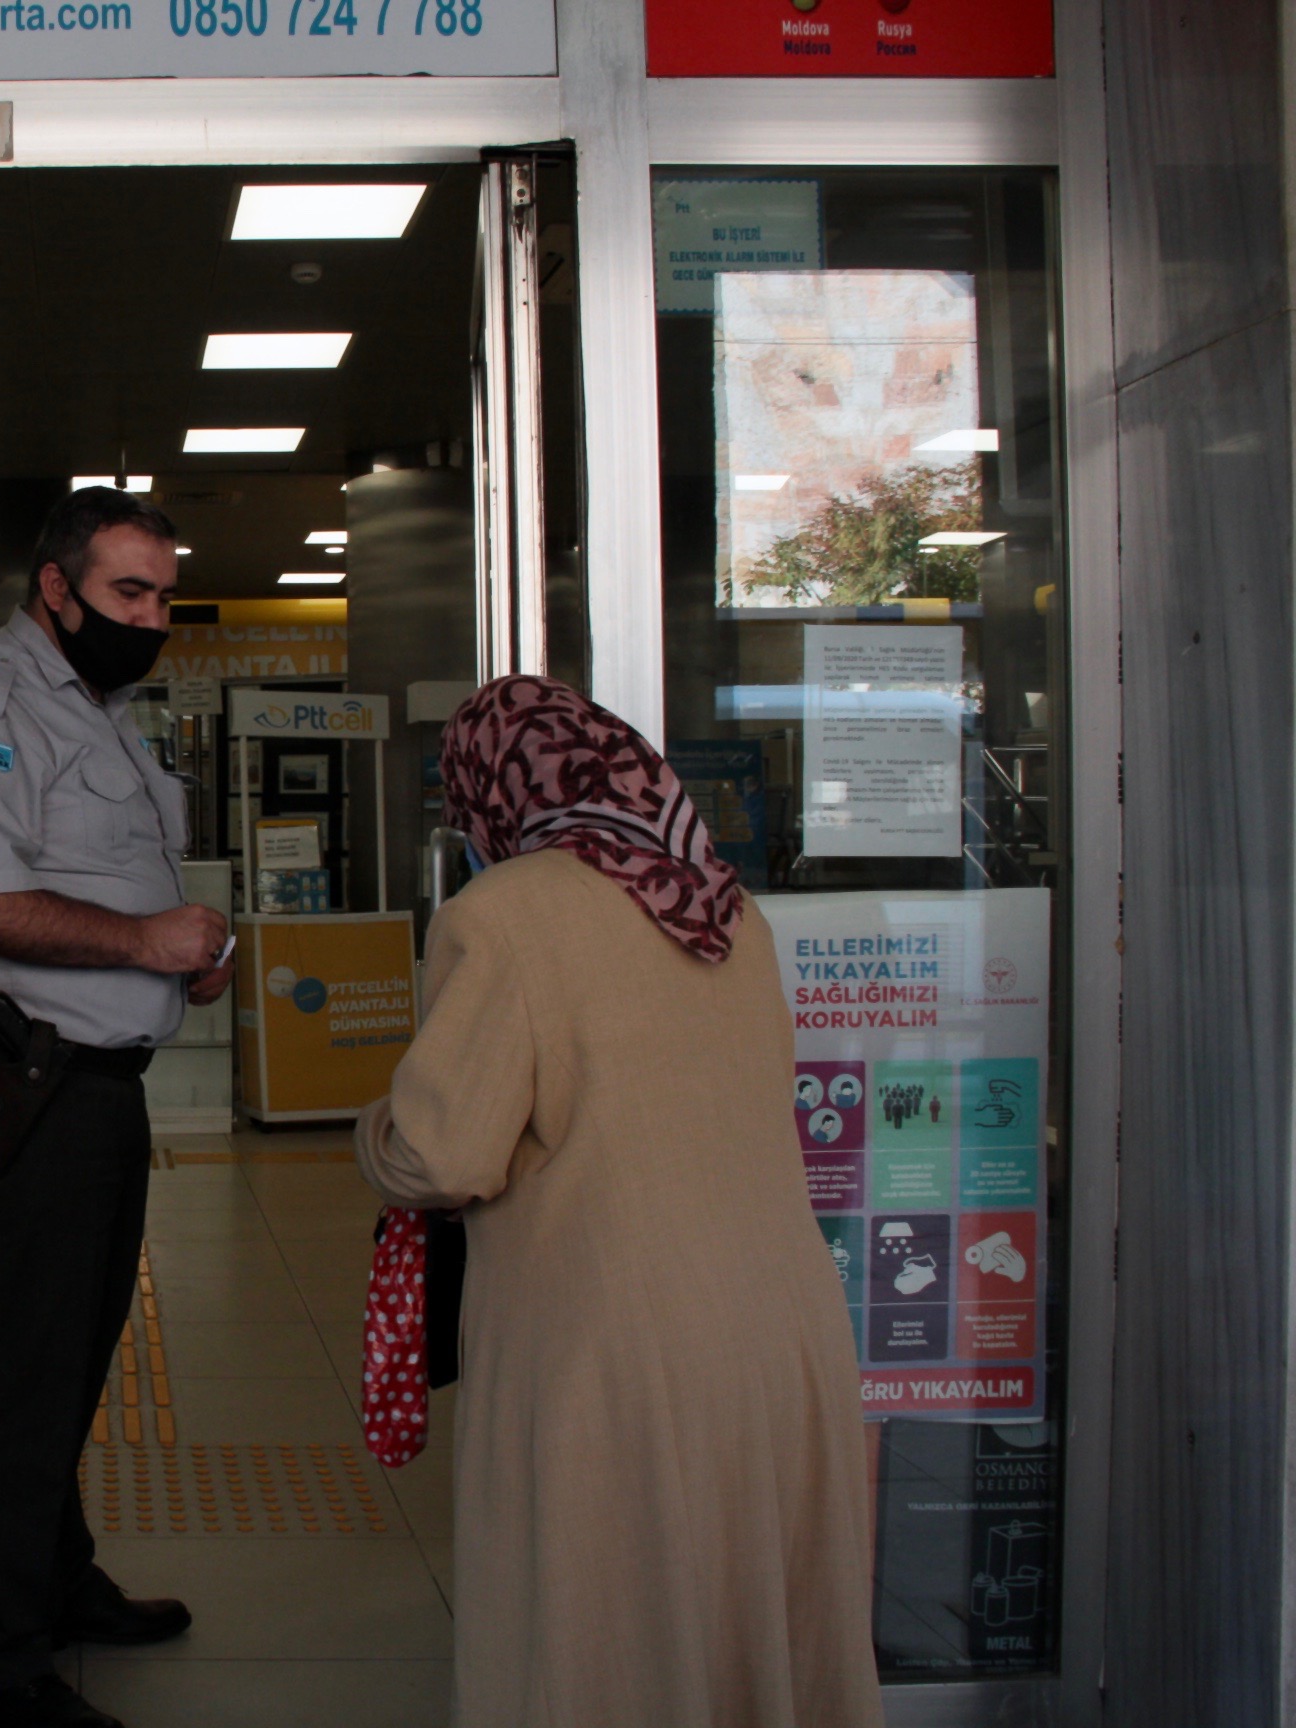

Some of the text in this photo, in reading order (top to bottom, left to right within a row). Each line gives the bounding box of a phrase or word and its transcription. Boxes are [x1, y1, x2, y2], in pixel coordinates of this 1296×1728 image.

[169, 0, 268, 37] 0850
[415, 0, 483, 37] 788
[782, 20, 830, 36] Moldova
[878, 20, 912, 39] Rusya
[783, 40, 831, 55] Moldova
[675, 203, 690, 214] Ptt
[712, 225, 761, 244] BU İŞYERİ
[669, 250, 723, 263] ELEKTRONİK
[725, 251, 753, 263] ALARM
[294, 702, 373, 731] Pttcell
[795, 934, 938, 956] ELLERİMİZİ
[795, 961, 939, 980] YIKAYALIM
[329, 997, 409, 1014] AVANTAJLI
[330, 1015, 410, 1032] DÜNYASINA
[795, 1009, 937, 1029] KORUYALIM
[861, 1379, 1024, 1401] ĞRU YIKAYALIM
[987, 1636, 1032, 1650] METAL
